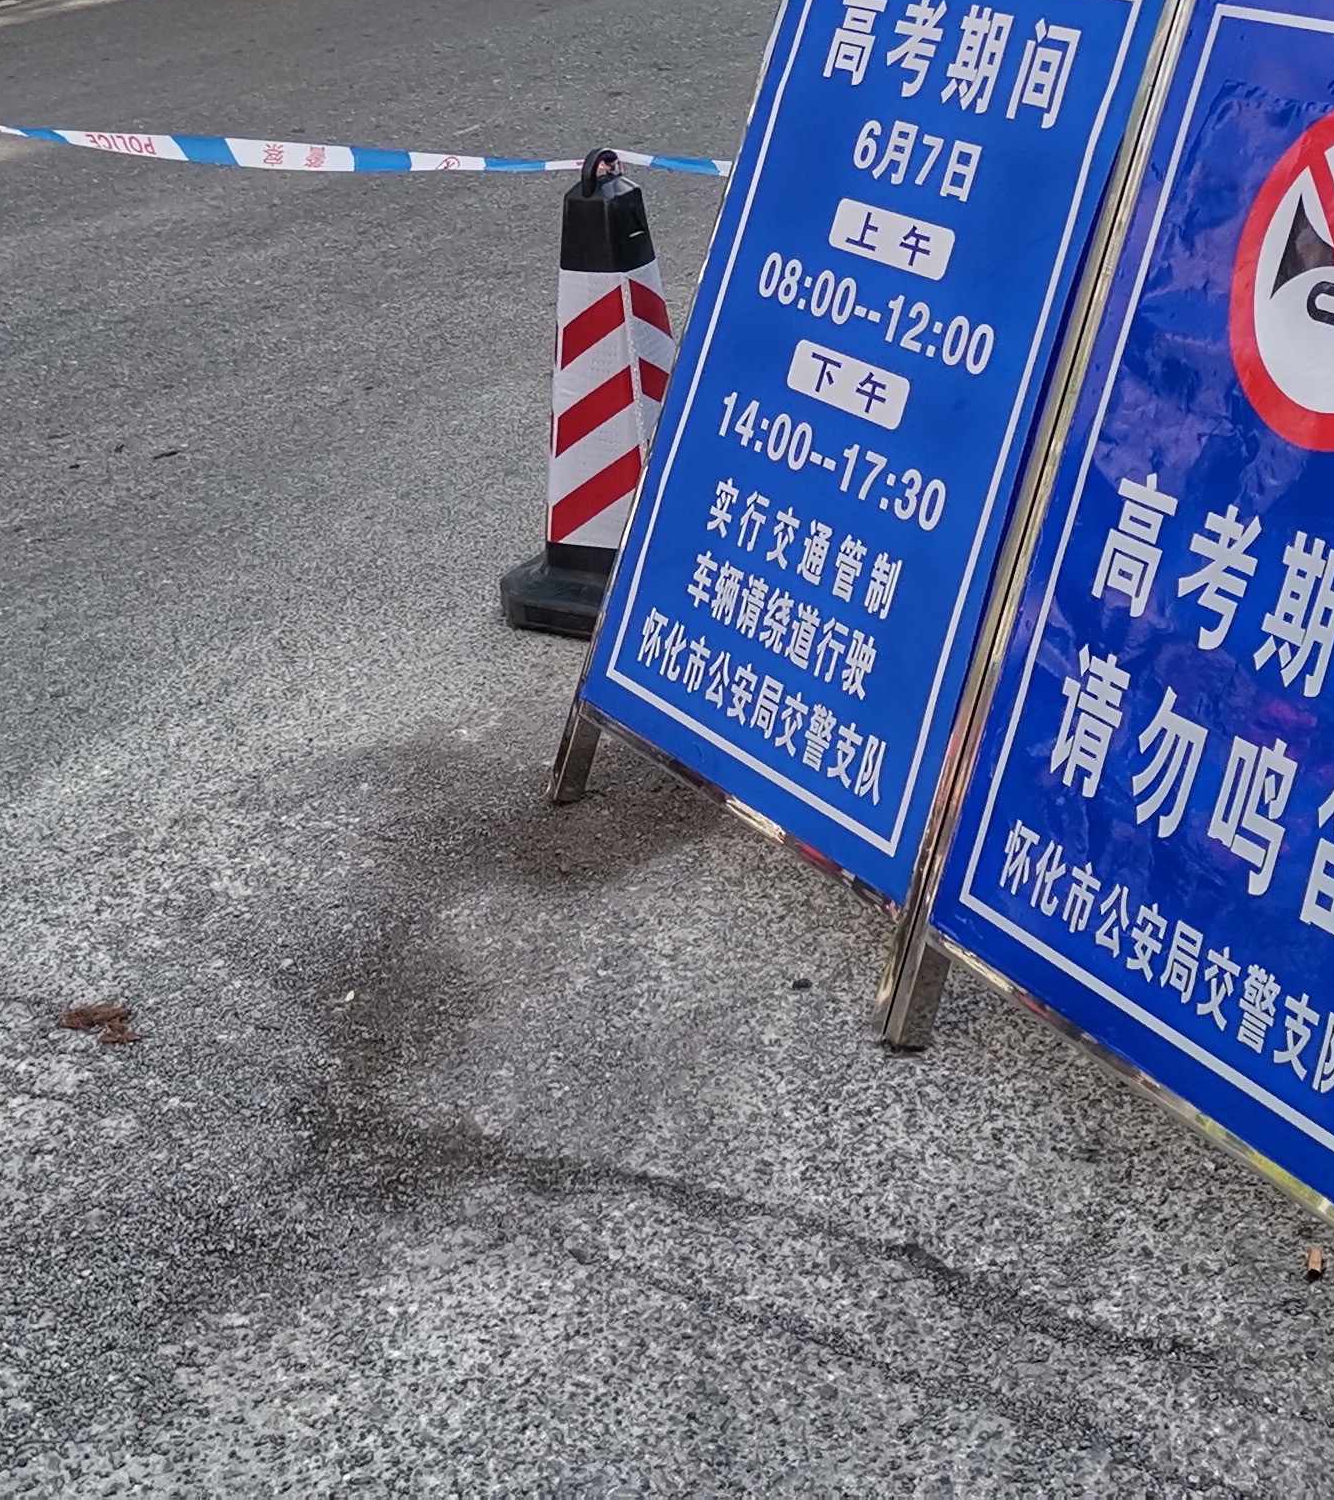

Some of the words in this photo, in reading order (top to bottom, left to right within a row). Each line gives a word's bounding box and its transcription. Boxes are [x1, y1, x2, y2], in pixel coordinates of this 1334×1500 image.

[86, 132, 156, 157] POLICE
[263, 143, 326, 168] 警察
[854, 120, 983, 202] 6月7日
[846, 213, 932, 266] 上午
[759, 252, 994, 374] 08:00--12:00
[809, 352, 888, 413] 下午
[719, 392, 946, 531] 14:00--17:30
[707, 479, 903, 620] 实行交通管制
[688, 552, 877, 700] 车辆请绕道行驶
[638, 608, 886, 805] 怀化市公安局交警支队
